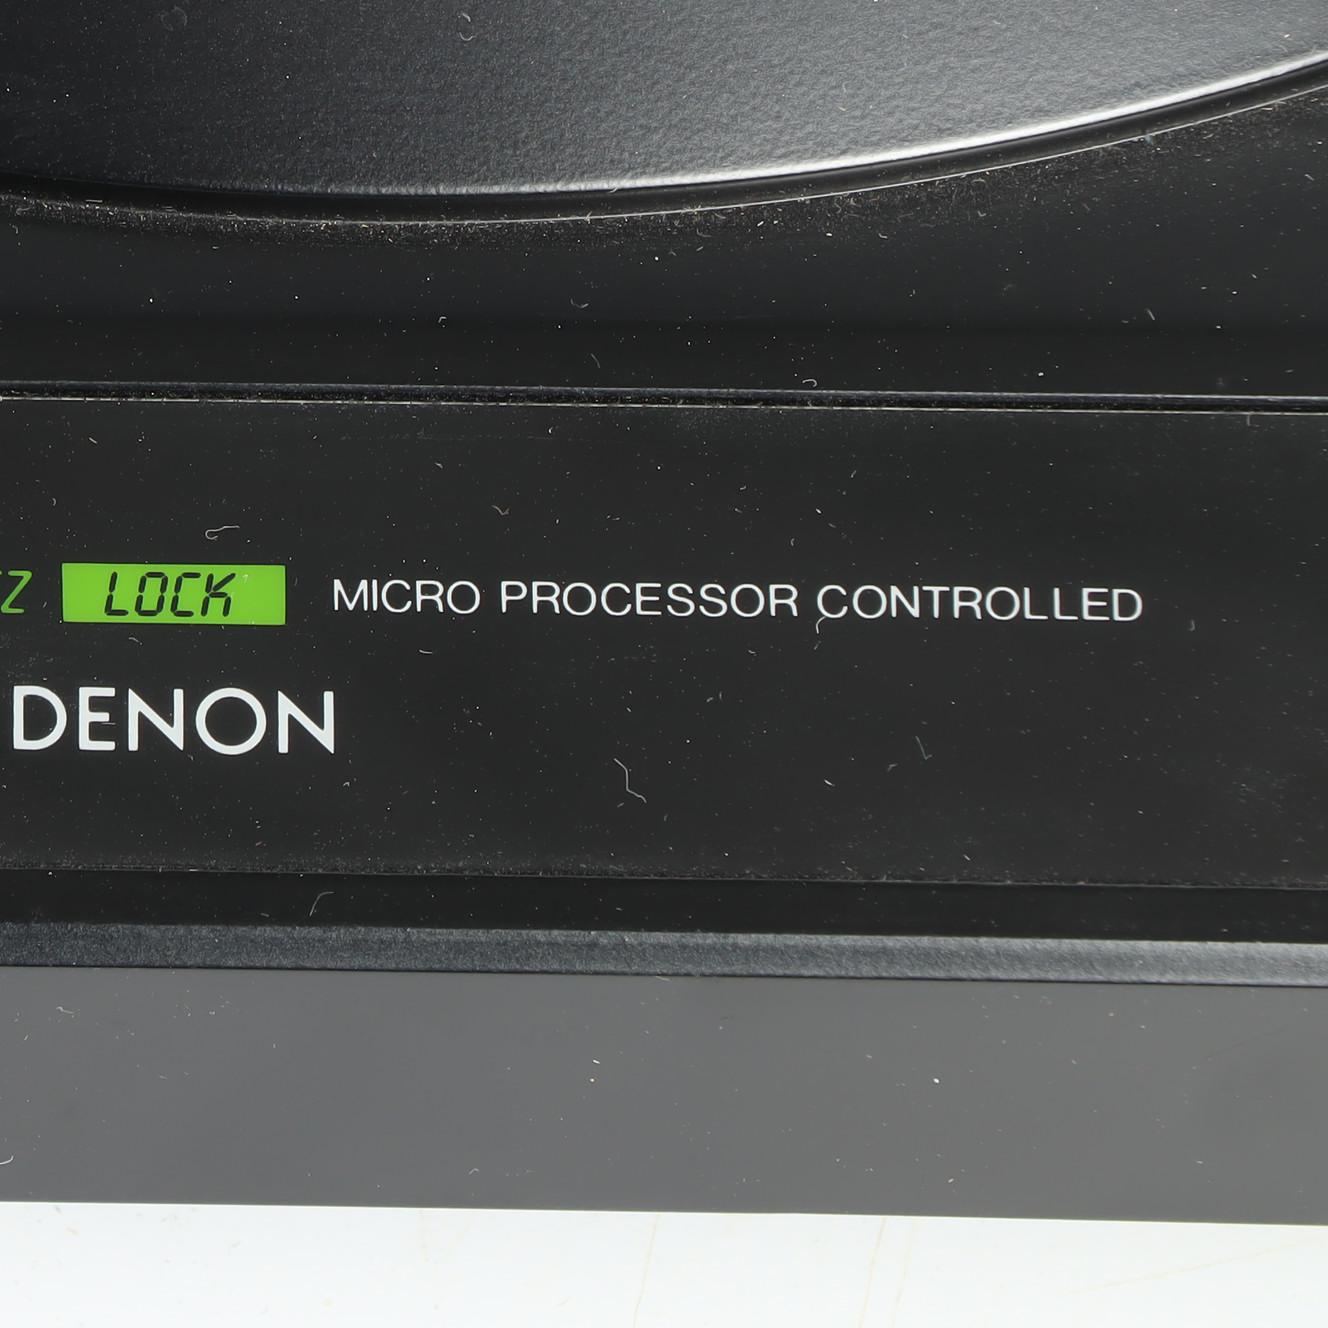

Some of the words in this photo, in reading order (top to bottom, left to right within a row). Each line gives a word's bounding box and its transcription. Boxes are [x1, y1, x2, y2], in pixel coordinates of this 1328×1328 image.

[105, 572, 235, 617] LOCK
[334, 579, 480, 614] MICRO
[501, 581, 797, 617] PROCESSOR
[817, 585, 1142, 621] CONTROLLED
[13, 686, 334, 755] DENON
